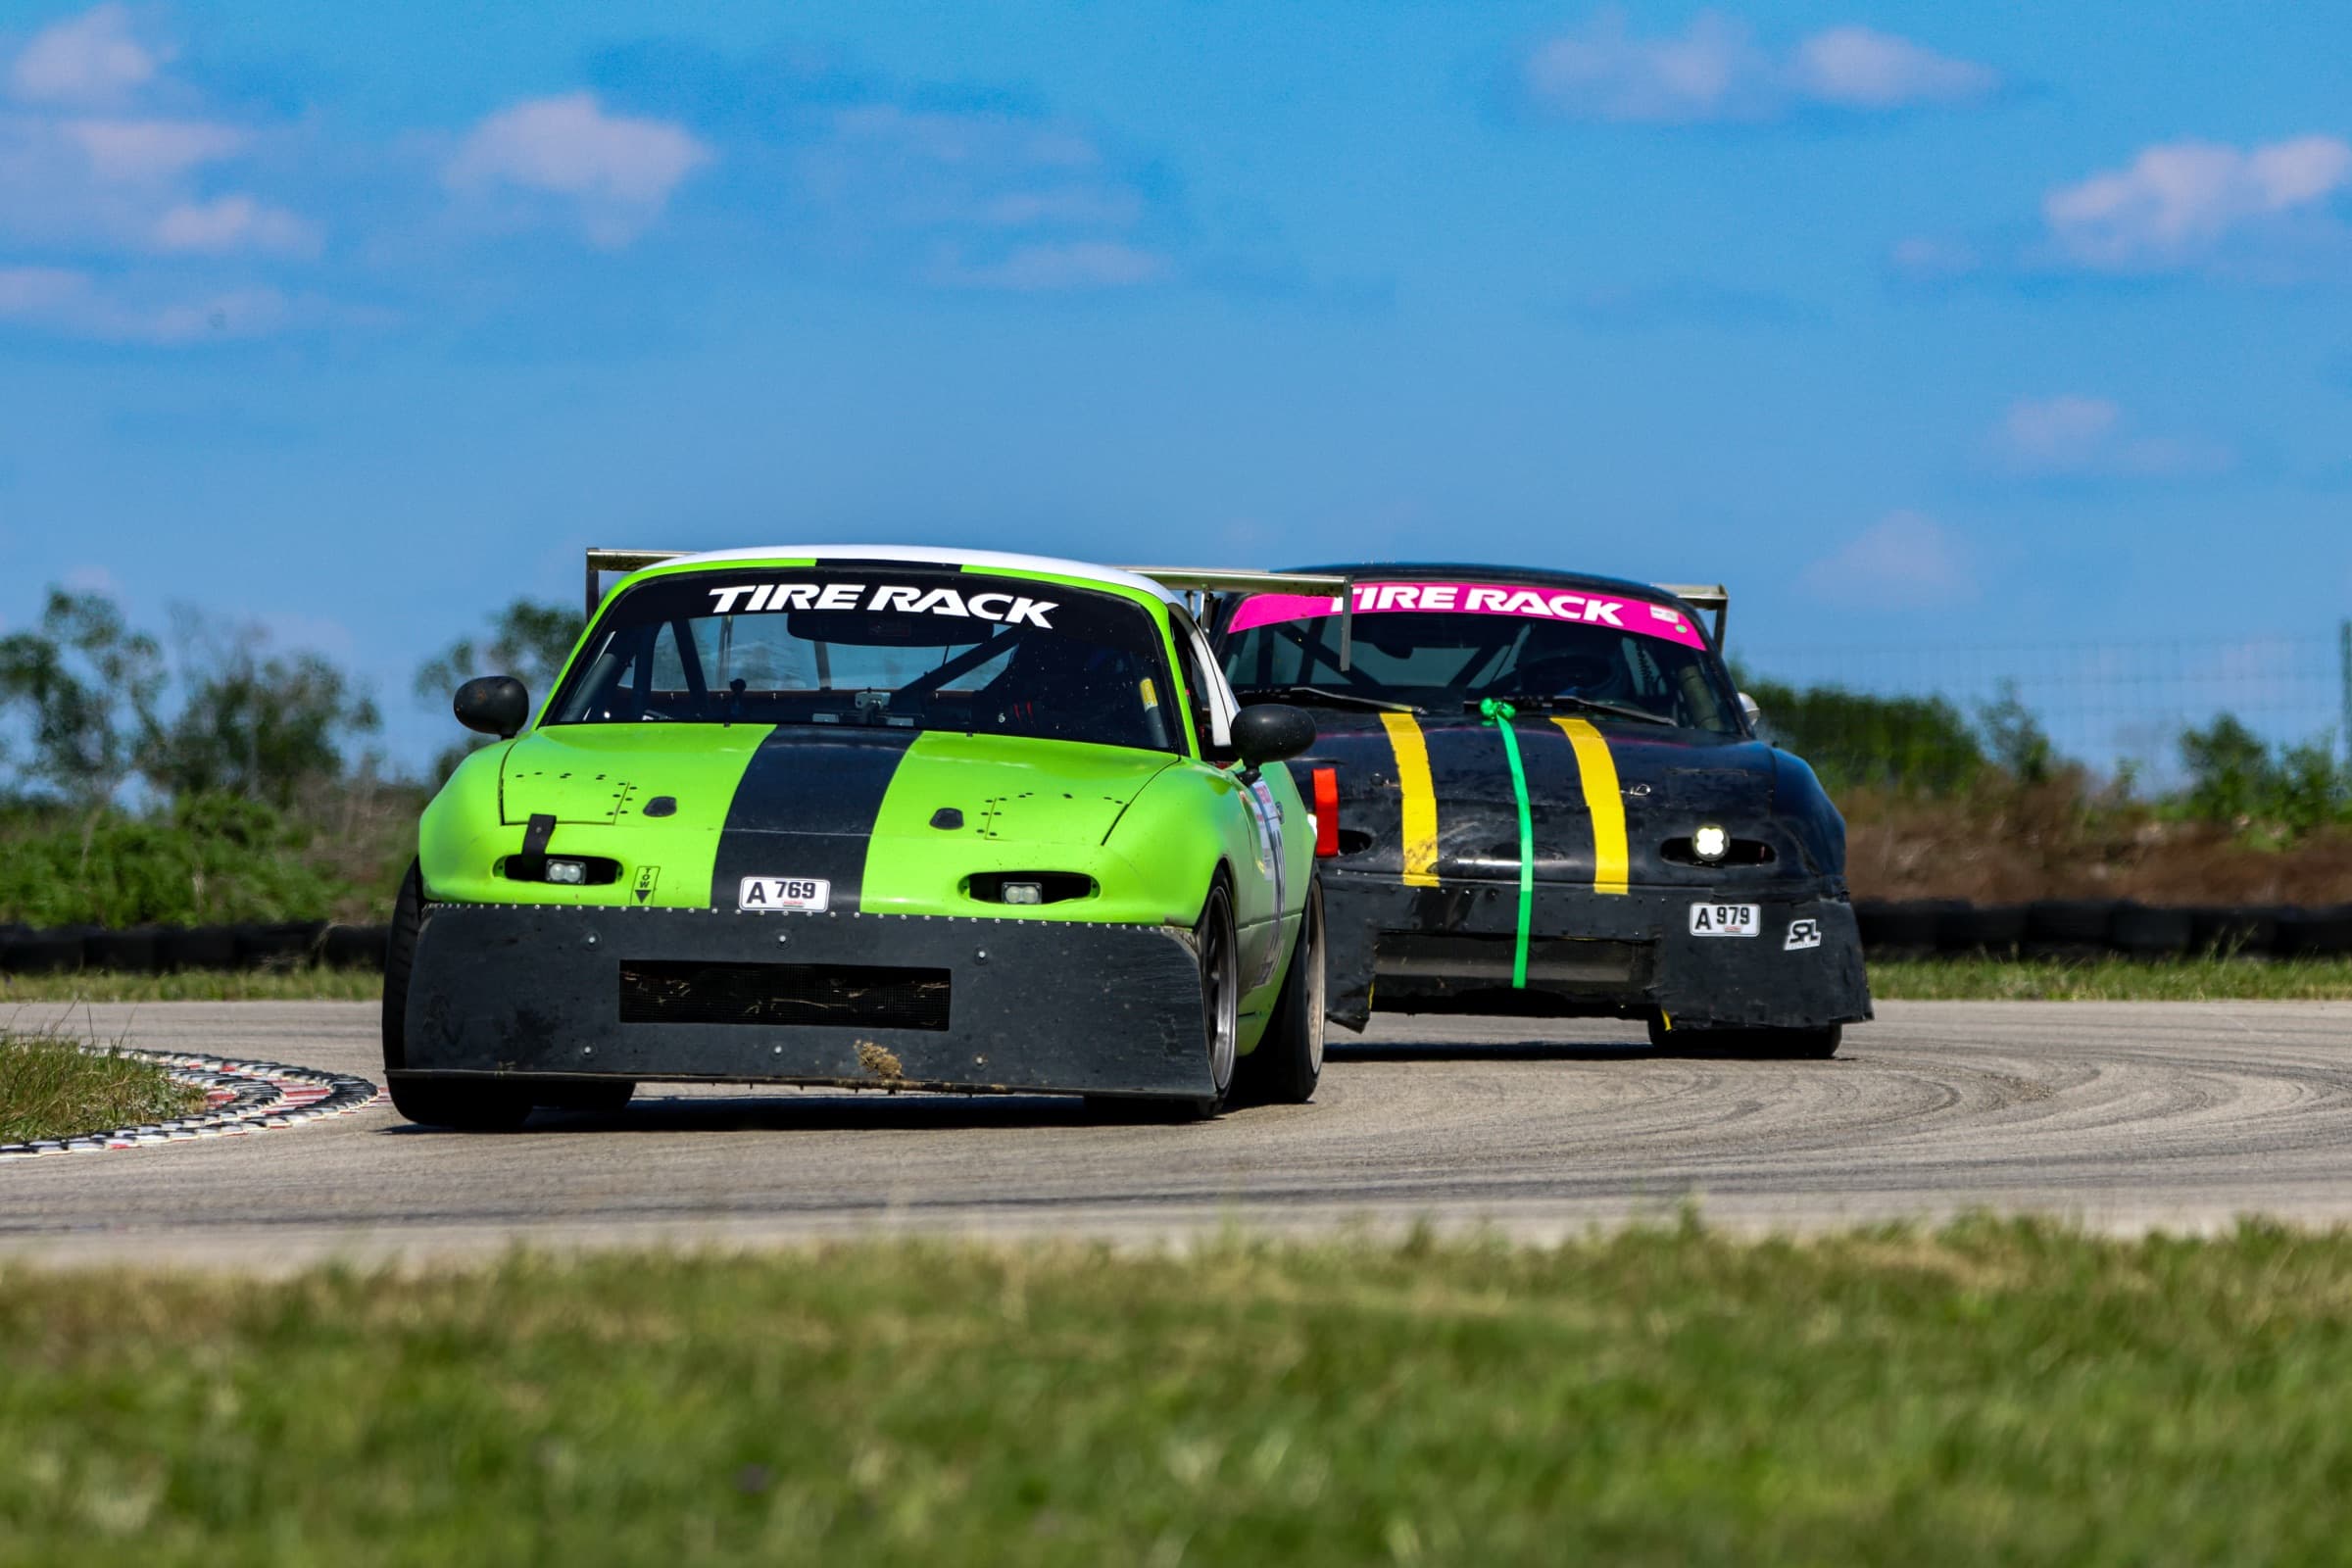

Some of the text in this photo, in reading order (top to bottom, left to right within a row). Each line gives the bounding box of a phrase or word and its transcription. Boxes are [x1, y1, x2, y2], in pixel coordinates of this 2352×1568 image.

[709, 584, 1059, 629] TIRE RACK
[1465, 588, 1624, 626] RACK
[639, 867, 652, 889] TOW
[746, 881, 816, 904] A 769
[1694, 906, 1750, 930] A 979
